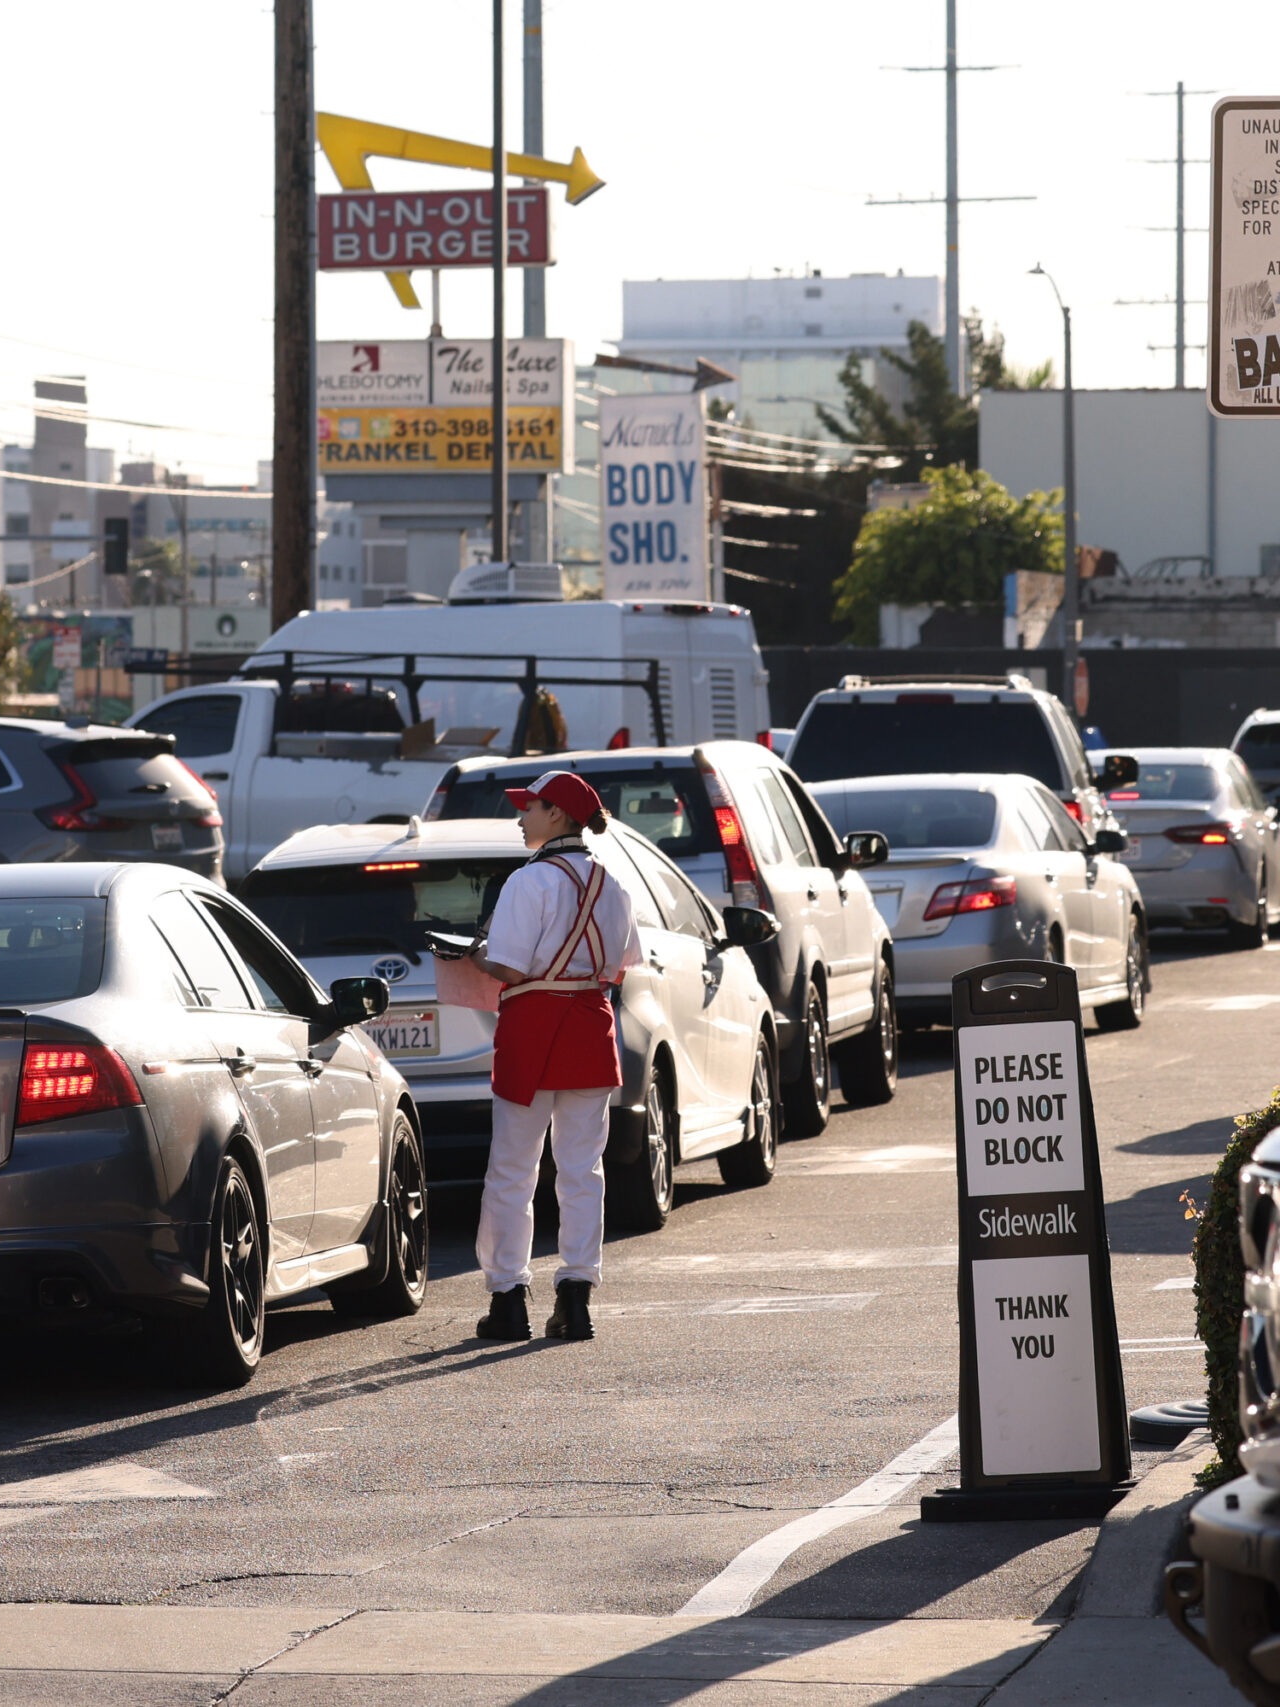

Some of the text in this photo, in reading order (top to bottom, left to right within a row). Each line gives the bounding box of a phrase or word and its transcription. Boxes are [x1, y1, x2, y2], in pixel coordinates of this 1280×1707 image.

[1242, 119, 1280, 134] UNAU
[1254, 180, 1280, 195] DIS
[332, 195, 537, 229] IN-N-OUT
[1241, 199, 1280, 215] SPEC
[1243, 220, 1272, 235] FOR
[332, 229, 531, 261] BURGER
[437, 346, 484, 374] The
[450, 379, 494, 395] Nails
[518, 378, 550, 398] Spa
[1254, 387, 1273, 403] ALL
[607, 460, 696, 506] BODY
[975, 1053, 1064, 1085] PLEASE
[976, 1093, 1067, 1126] DO NOT
[985, 1135, 1064, 1167] BLOCK
[979, 1203, 1077, 1239] Sidewalk
[995, 1294, 1069, 1321] THANK
[1011, 1335, 1055, 1360] YOU
